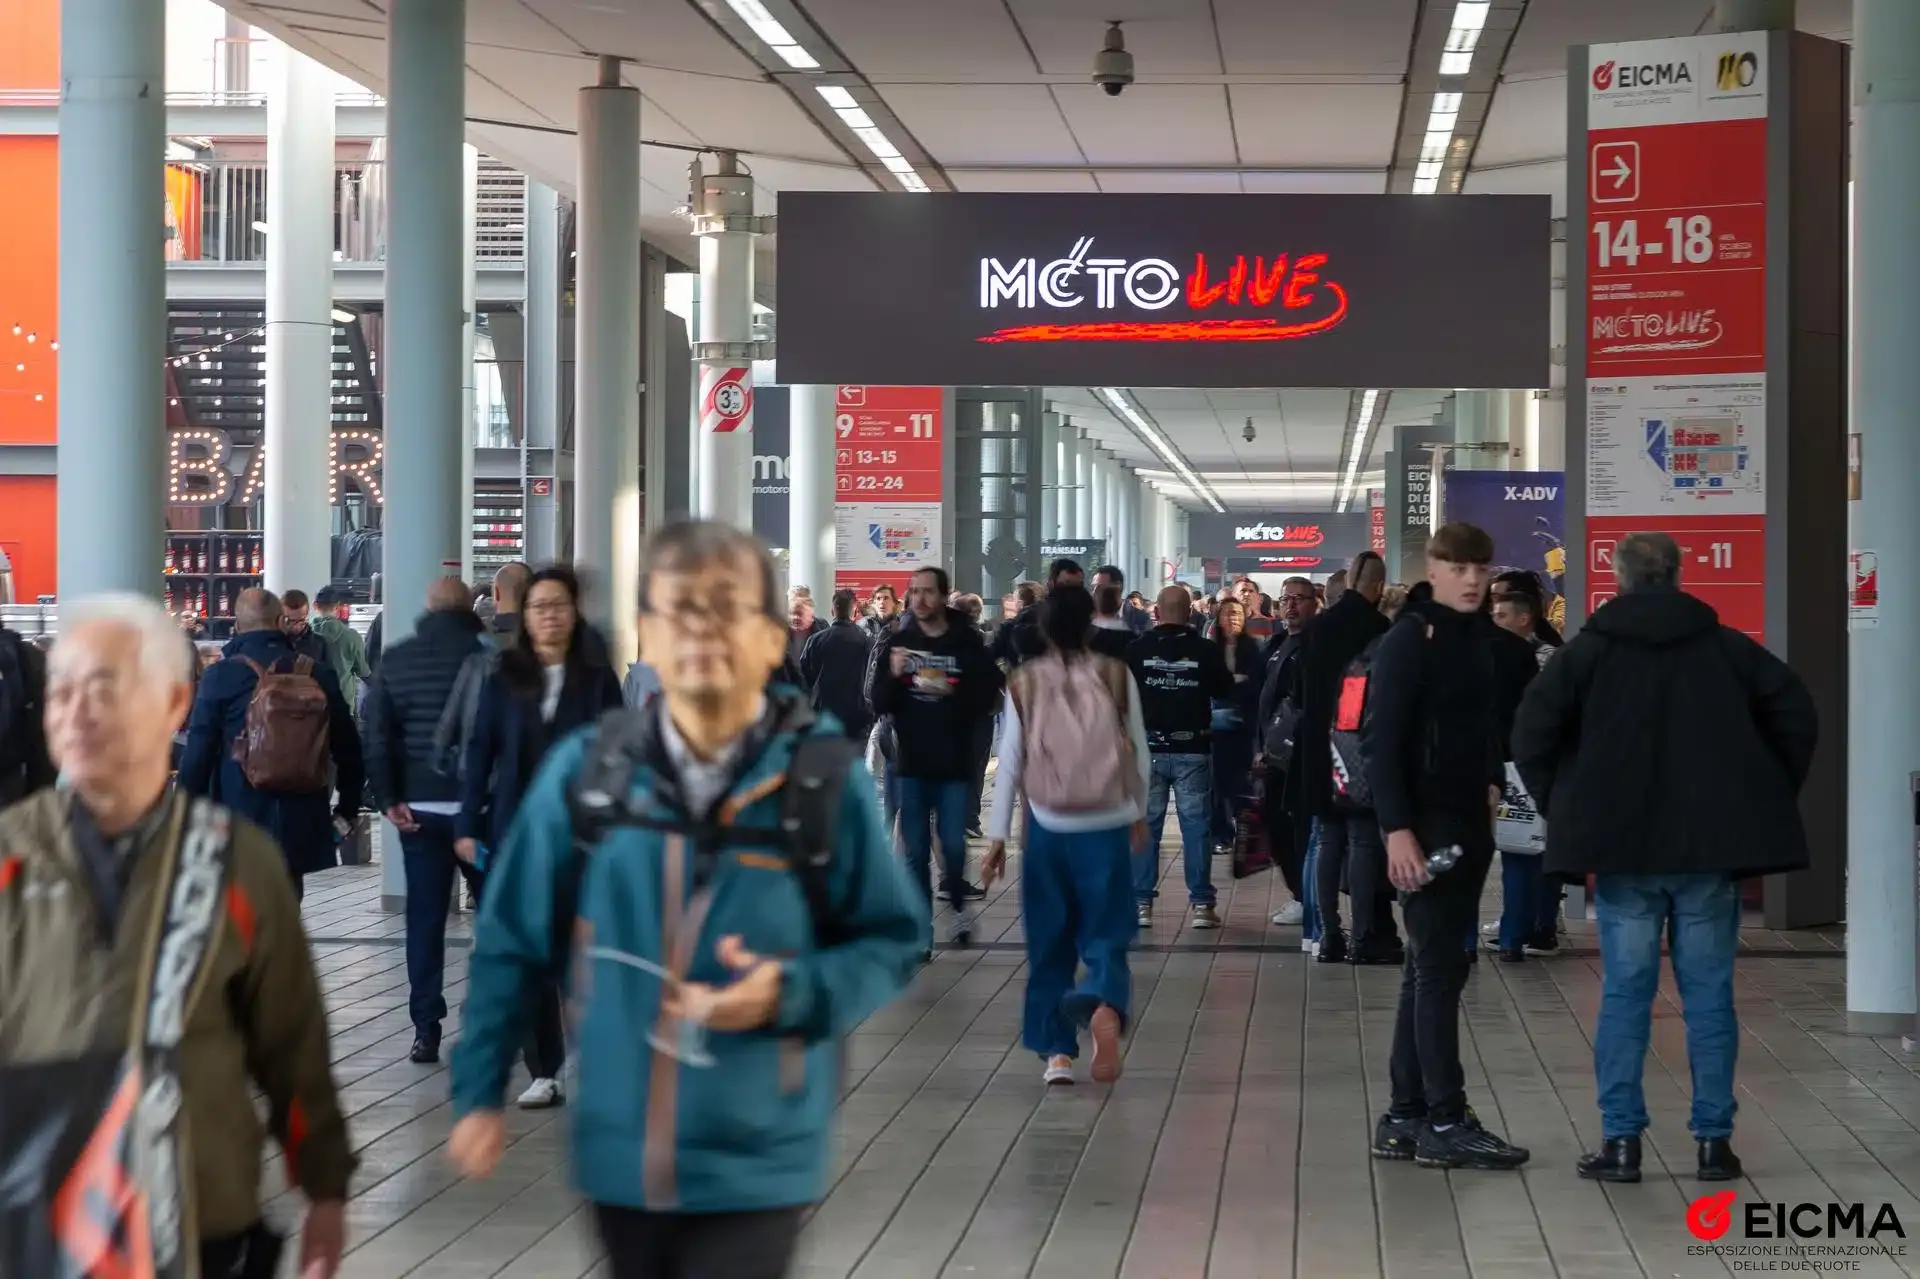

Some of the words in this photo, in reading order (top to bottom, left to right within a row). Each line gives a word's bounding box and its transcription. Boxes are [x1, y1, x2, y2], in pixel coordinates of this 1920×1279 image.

[1618, 62, 1692, 88] EICMA
[1592, 214, 1714, 268] 14-18
[1186, 252, 1329, 309] LIVE
[836, 413, 855, 438] 9
[856, 450, 897, 464] 13-15
[856, 476, 904, 490] 22-24
[1504, 486, 1558, 501] X-ADV
[1041, 546, 1087, 555] TRANSALP
